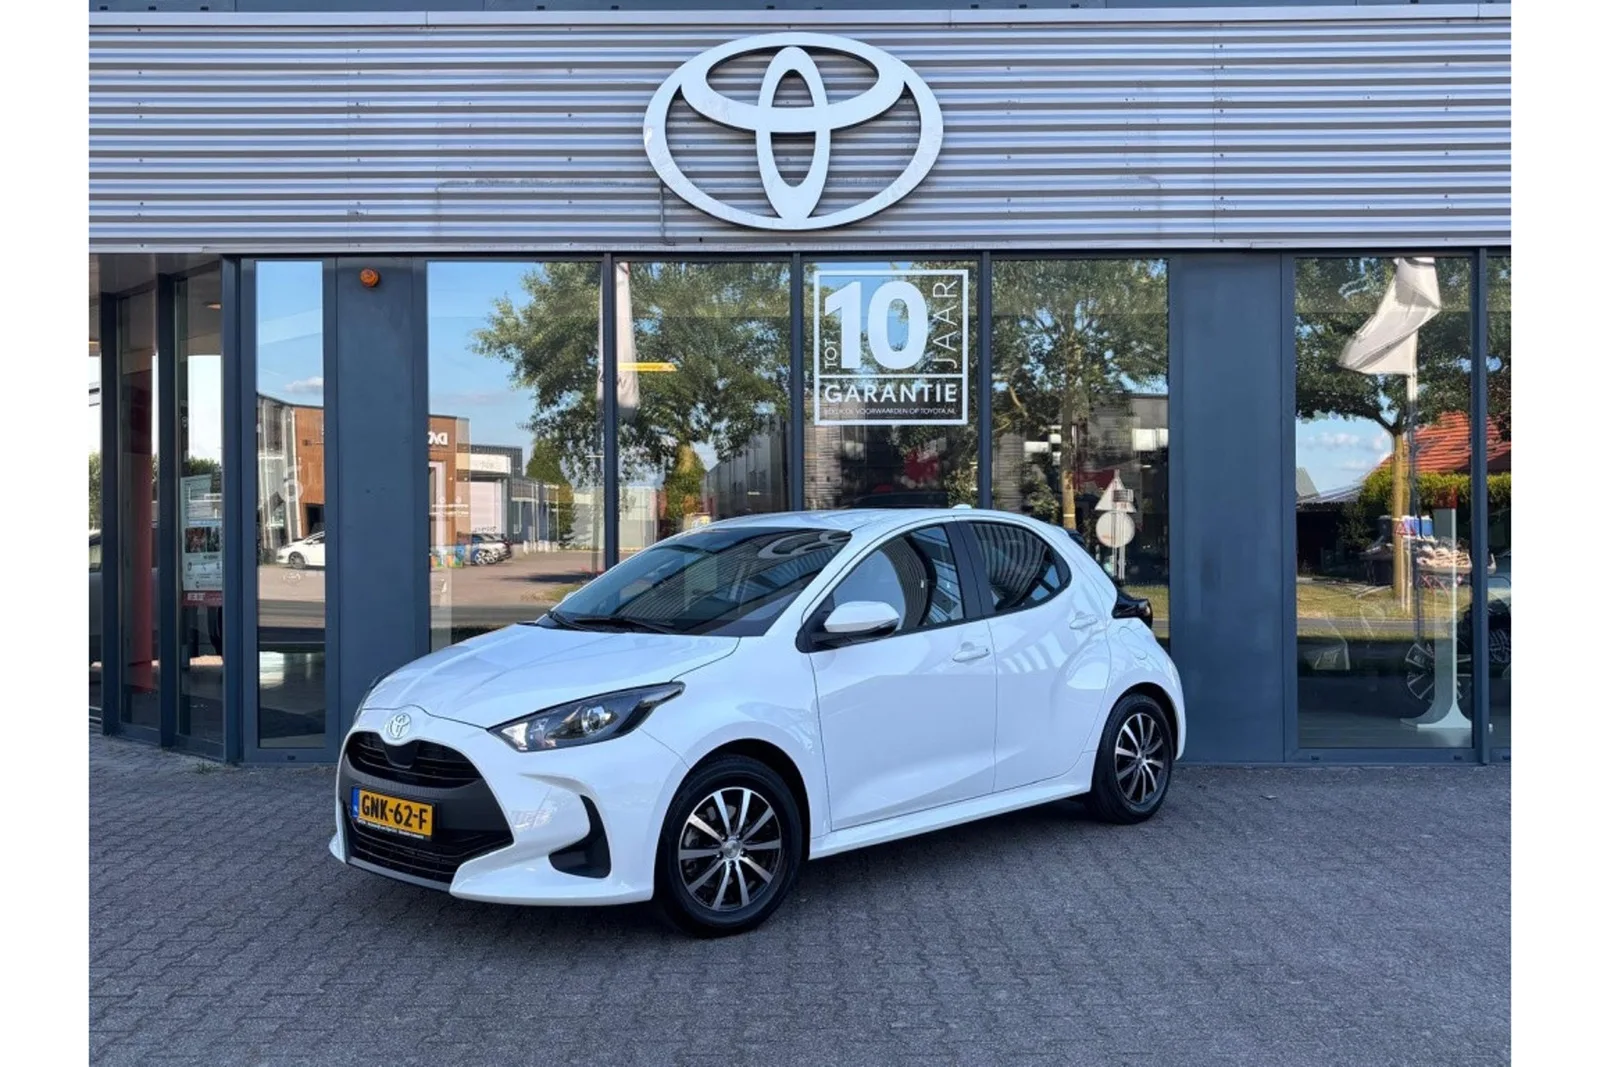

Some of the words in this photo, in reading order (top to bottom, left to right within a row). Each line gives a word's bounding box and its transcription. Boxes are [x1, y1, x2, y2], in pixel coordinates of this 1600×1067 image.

[825, 281, 928, 370] 10
[933, 280, 957, 368] JAAR
[825, 339, 837, 368] TOT
[825, 383, 957, 402] GARANTIE
[362, 794, 428, 830] GNK-62-F
